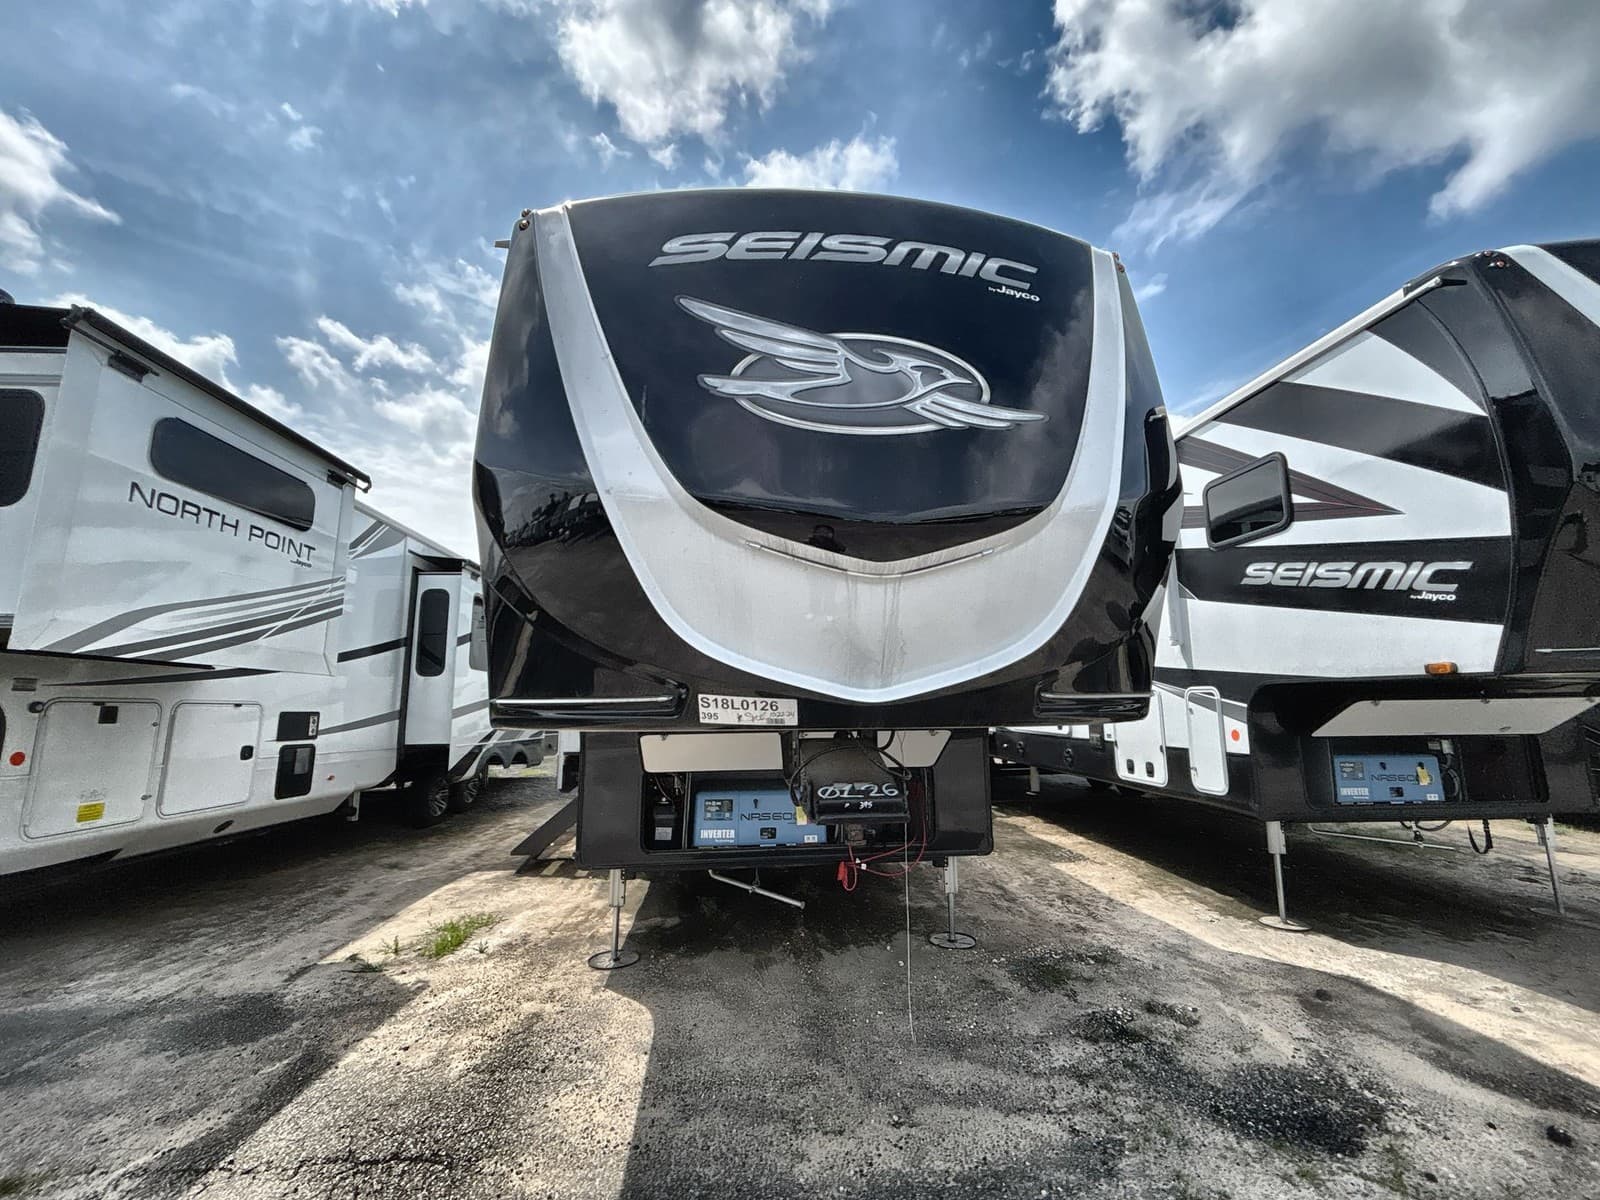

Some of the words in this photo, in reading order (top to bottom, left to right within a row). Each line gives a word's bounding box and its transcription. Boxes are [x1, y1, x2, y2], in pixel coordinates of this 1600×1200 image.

[648, 231, 1038, 290] SEISMIC
[996, 285, 1040, 302] Jayco
[129, 481, 239, 537] NORTH
[248, 524, 316, 561] POINT
[1240, 561, 1474, 592] SEISMIC
[1416, 591, 1456, 602] Jayco
[700, 697, 779, 712] S18L0126
[701, 712, 719, 720] 395
[700, 829, 735, 839] INVERTER
